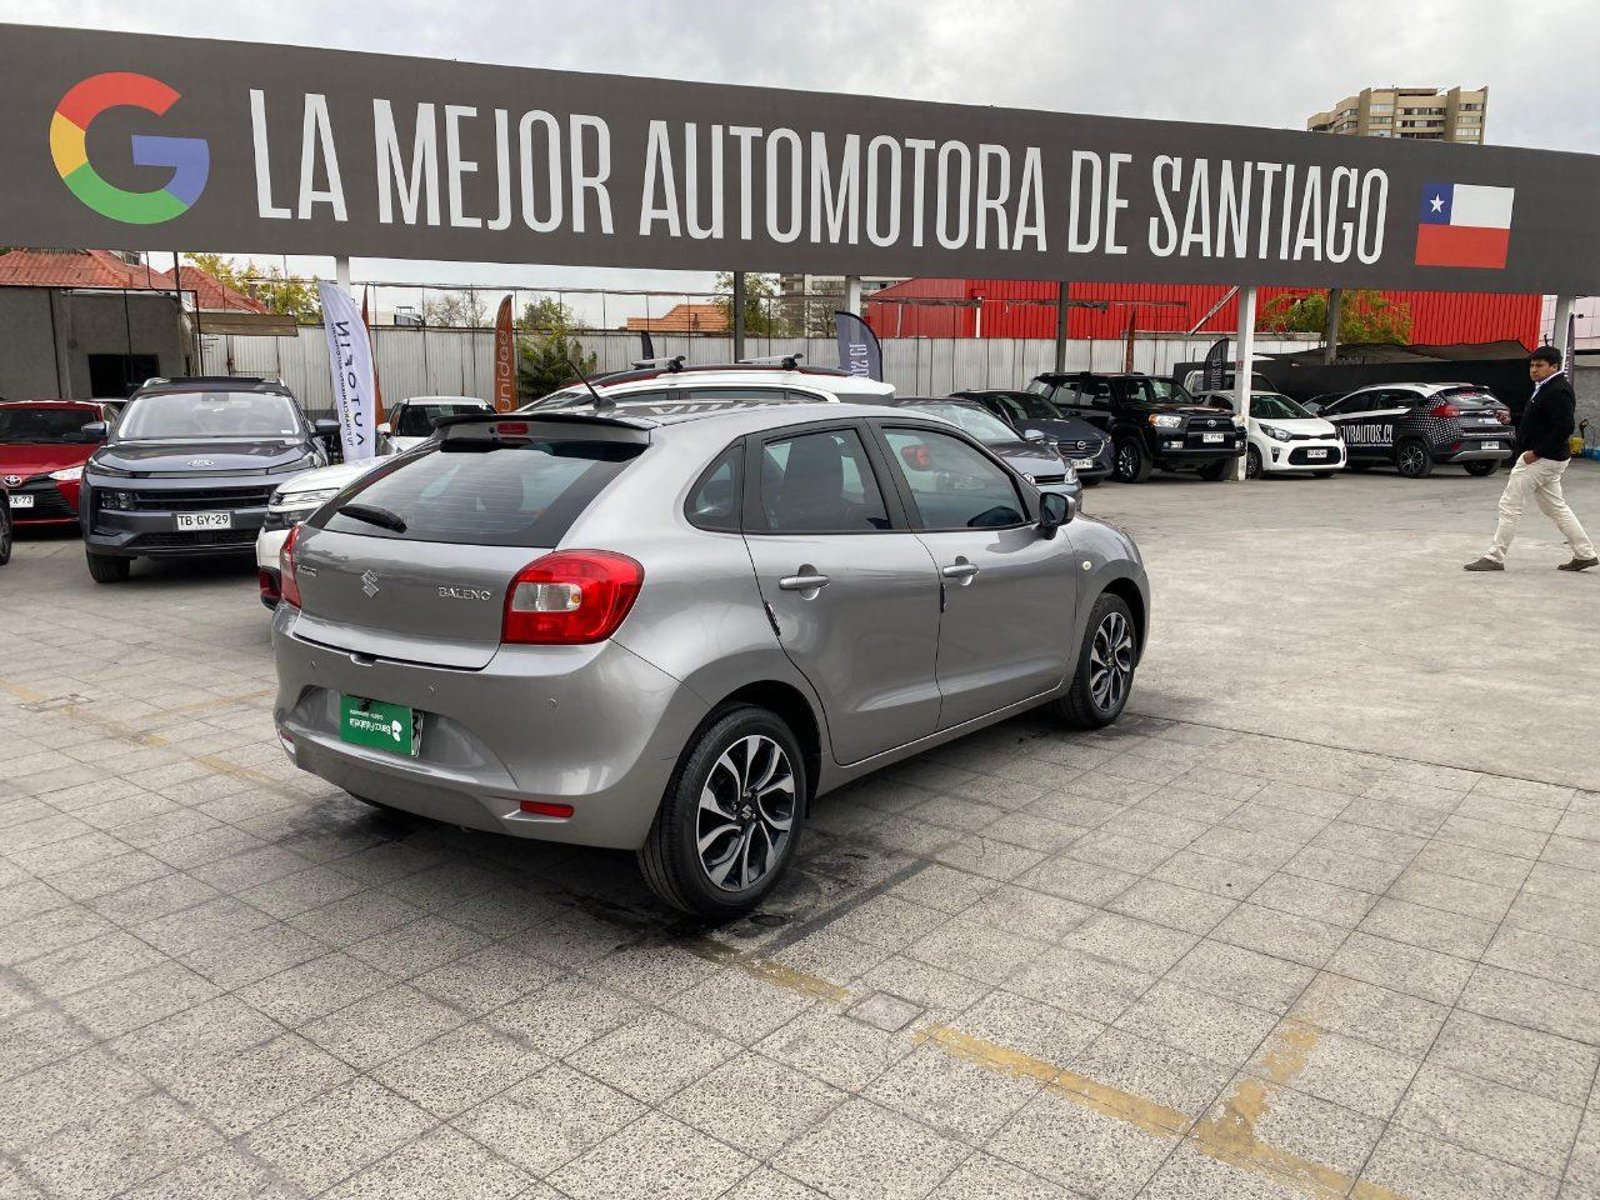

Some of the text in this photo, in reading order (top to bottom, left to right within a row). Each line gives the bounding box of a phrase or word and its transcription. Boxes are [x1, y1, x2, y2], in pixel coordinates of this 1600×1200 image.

[250, 89, 1388, 264] LA MEJOR AUTOMOTORA DE SANTIAGO
[438, 586, 491, 601] BALENO
